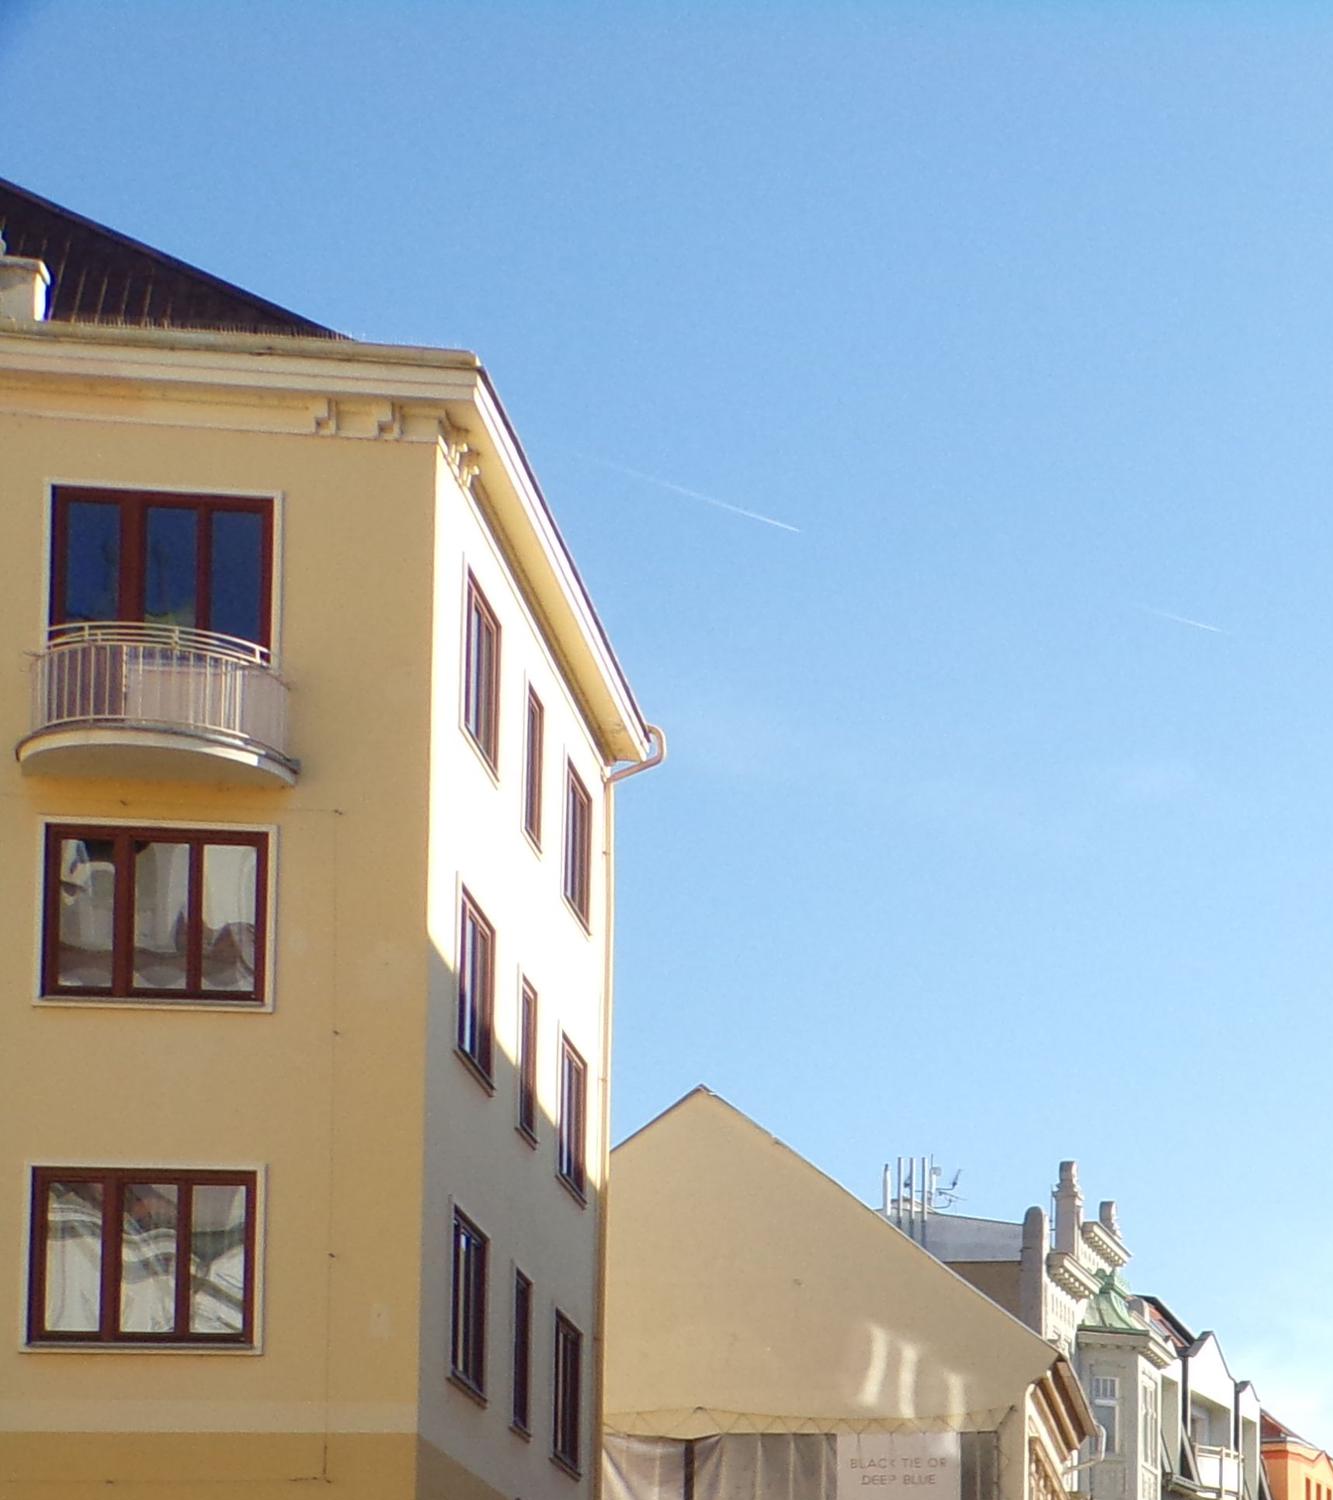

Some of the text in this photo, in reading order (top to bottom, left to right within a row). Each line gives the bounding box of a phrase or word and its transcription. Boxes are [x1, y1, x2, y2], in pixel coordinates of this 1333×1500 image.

[902, 1458, 921, 1469] TIE
[927, 1457, 947, 1468] OR
[860, 1474, 937, 1485] DEEP BLUE
